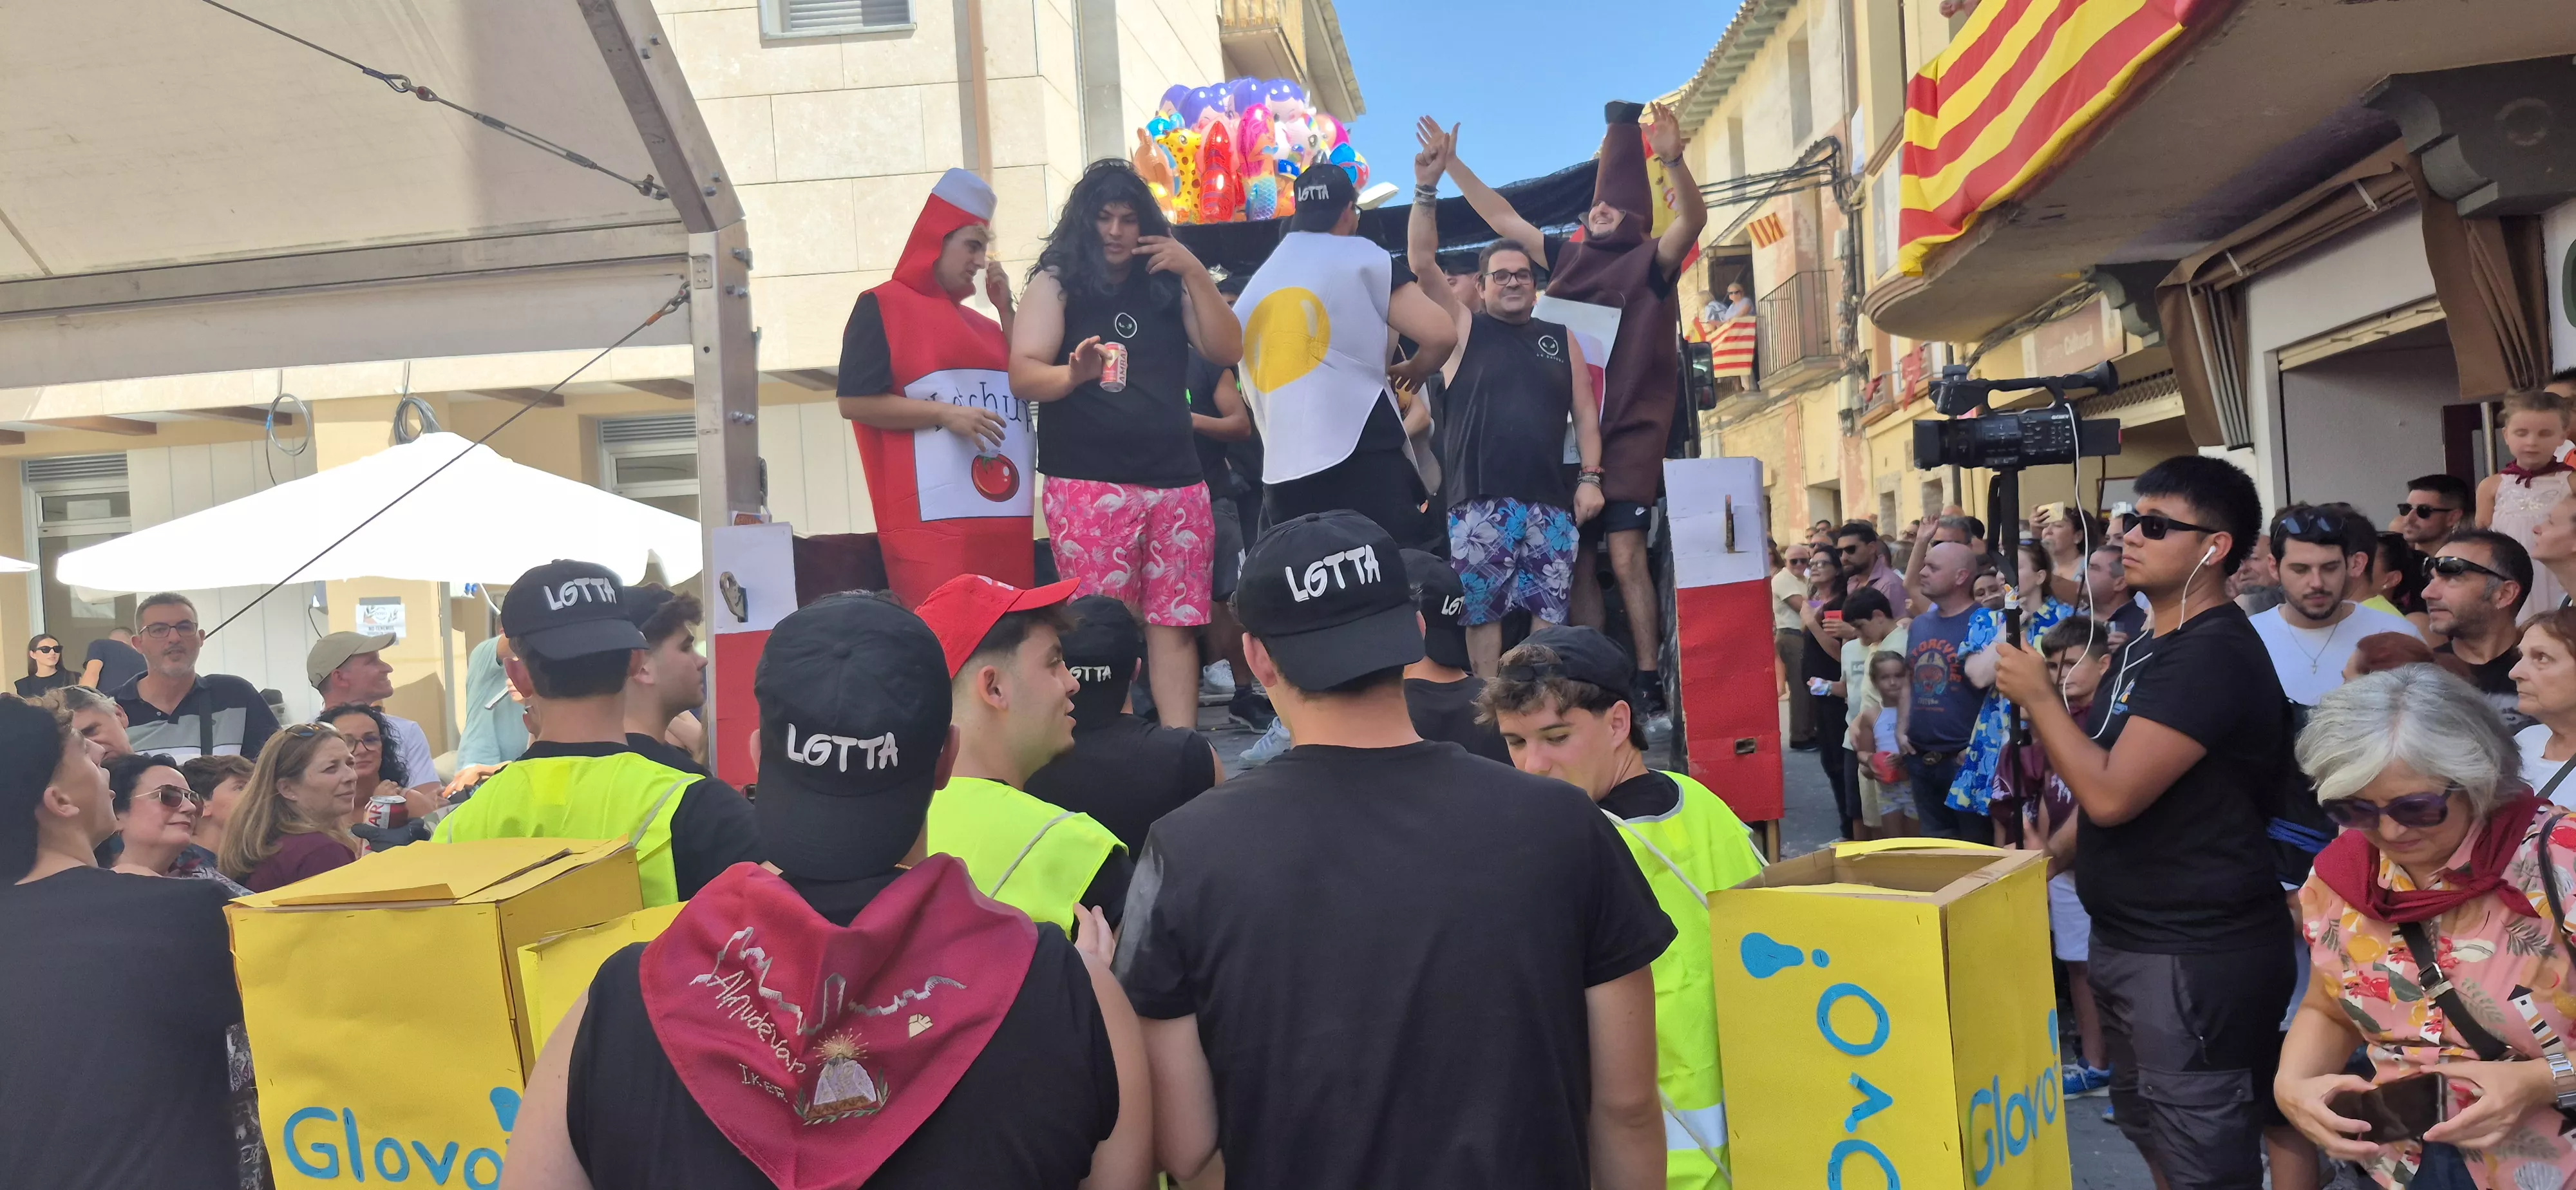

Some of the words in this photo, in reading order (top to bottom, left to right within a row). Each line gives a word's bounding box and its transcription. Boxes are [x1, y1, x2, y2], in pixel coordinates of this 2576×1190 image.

[1298, 184, 1329, 202] LGTTA
[544, 577, 617, 610] LGTTA
[1284, 544, 1381, 602] LGTTA
[788, 722, 898, 772] LGTTA
